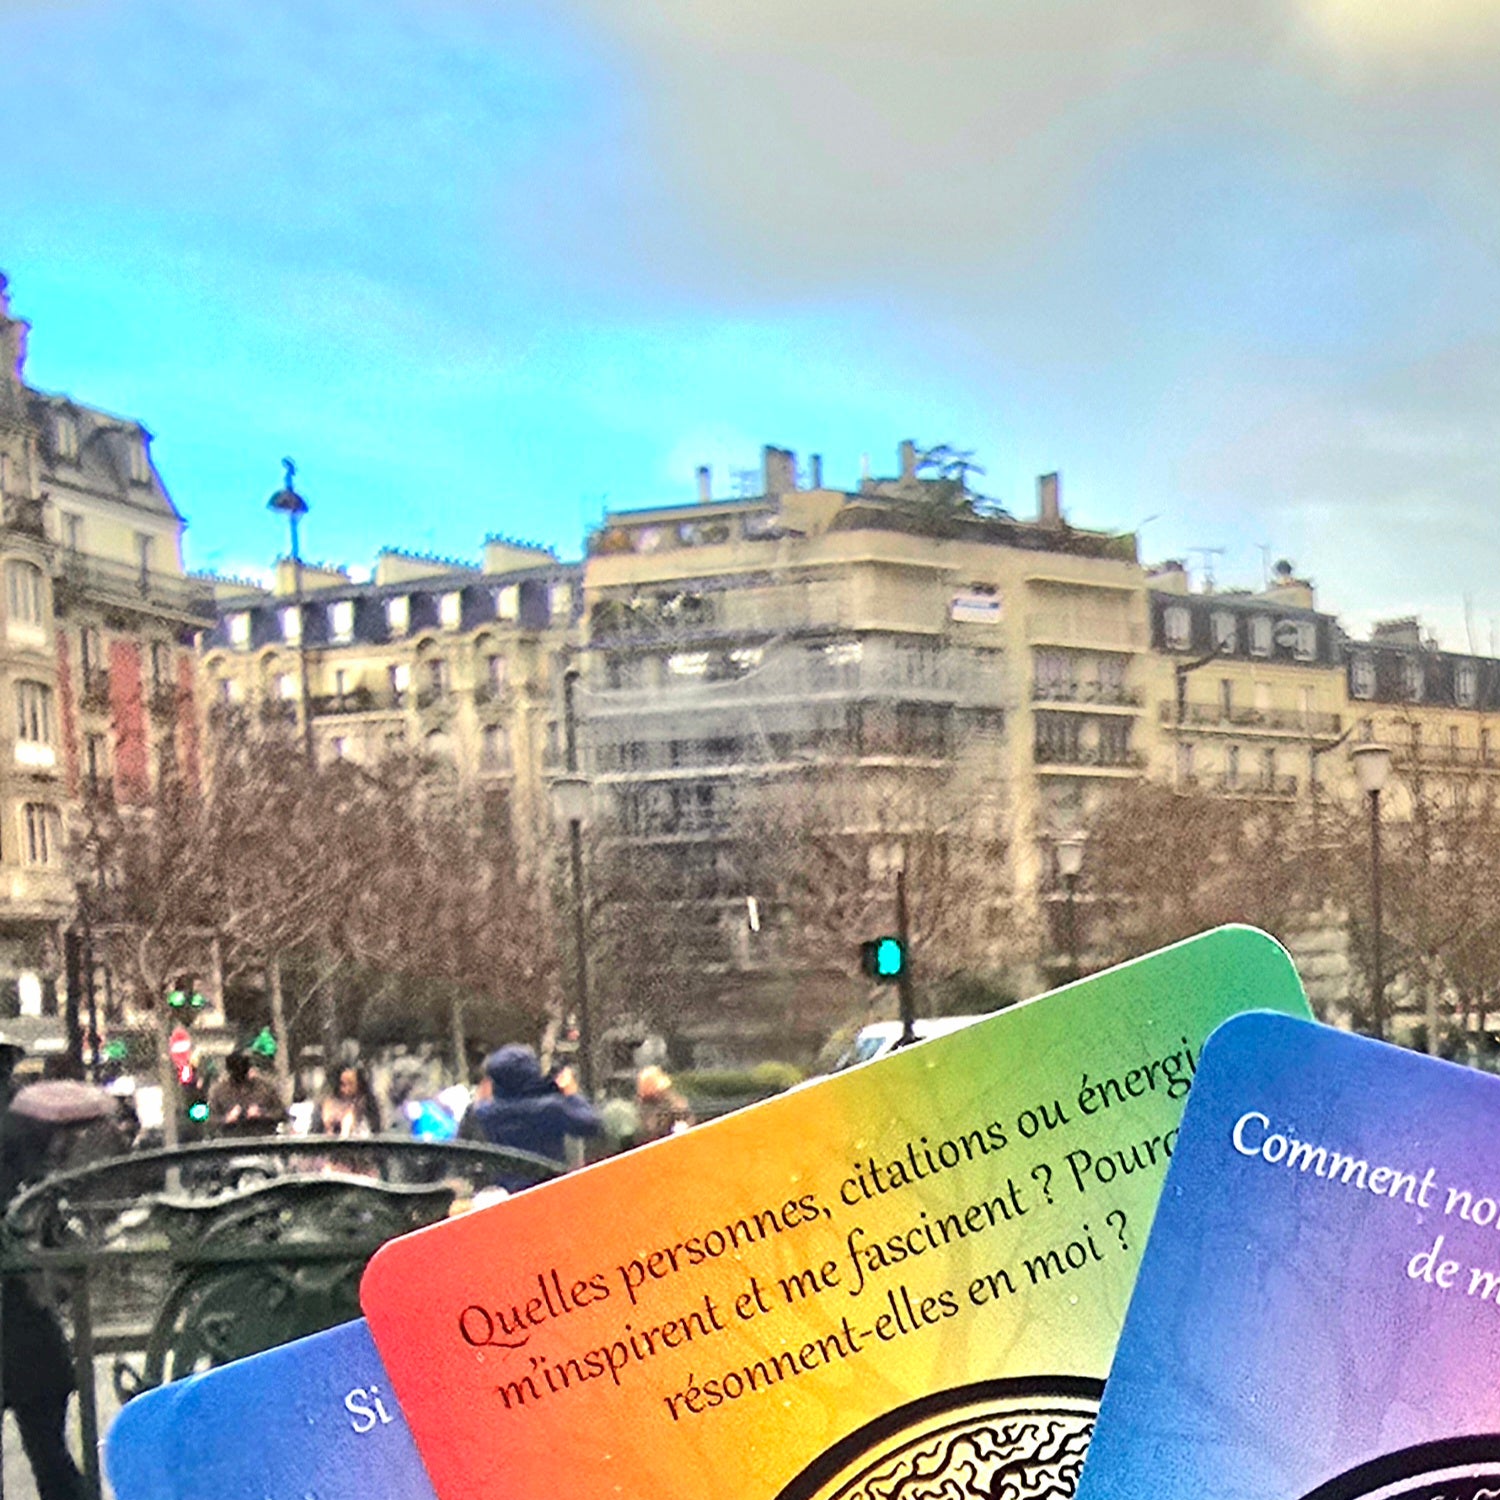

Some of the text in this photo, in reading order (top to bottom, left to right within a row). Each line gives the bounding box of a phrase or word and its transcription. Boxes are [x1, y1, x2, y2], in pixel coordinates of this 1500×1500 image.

[458, 1267, 611, 1350] Quelles
[616, 1193, 833, 1306] personnes,
[839, 1120, 1009, 1207] citations
[1016, 1099, 1072, 1140] ou
[1231, 1110, 1437, 1209] Comment
[497, 1293, 728, 1410] m'inspirent
[734, 1276, 773, 1322] et
[776, 1259, 843, 1304] me
[846, 1177, 1031, 1298] fascinent
[1029, 1162, 1055, 1206] ?
[662, 1208, 1130, 1422] résonnent-elles en moi ?
[1406, 1233, 1460, 1290] de
[344, 1385, 394, 1434] Si
